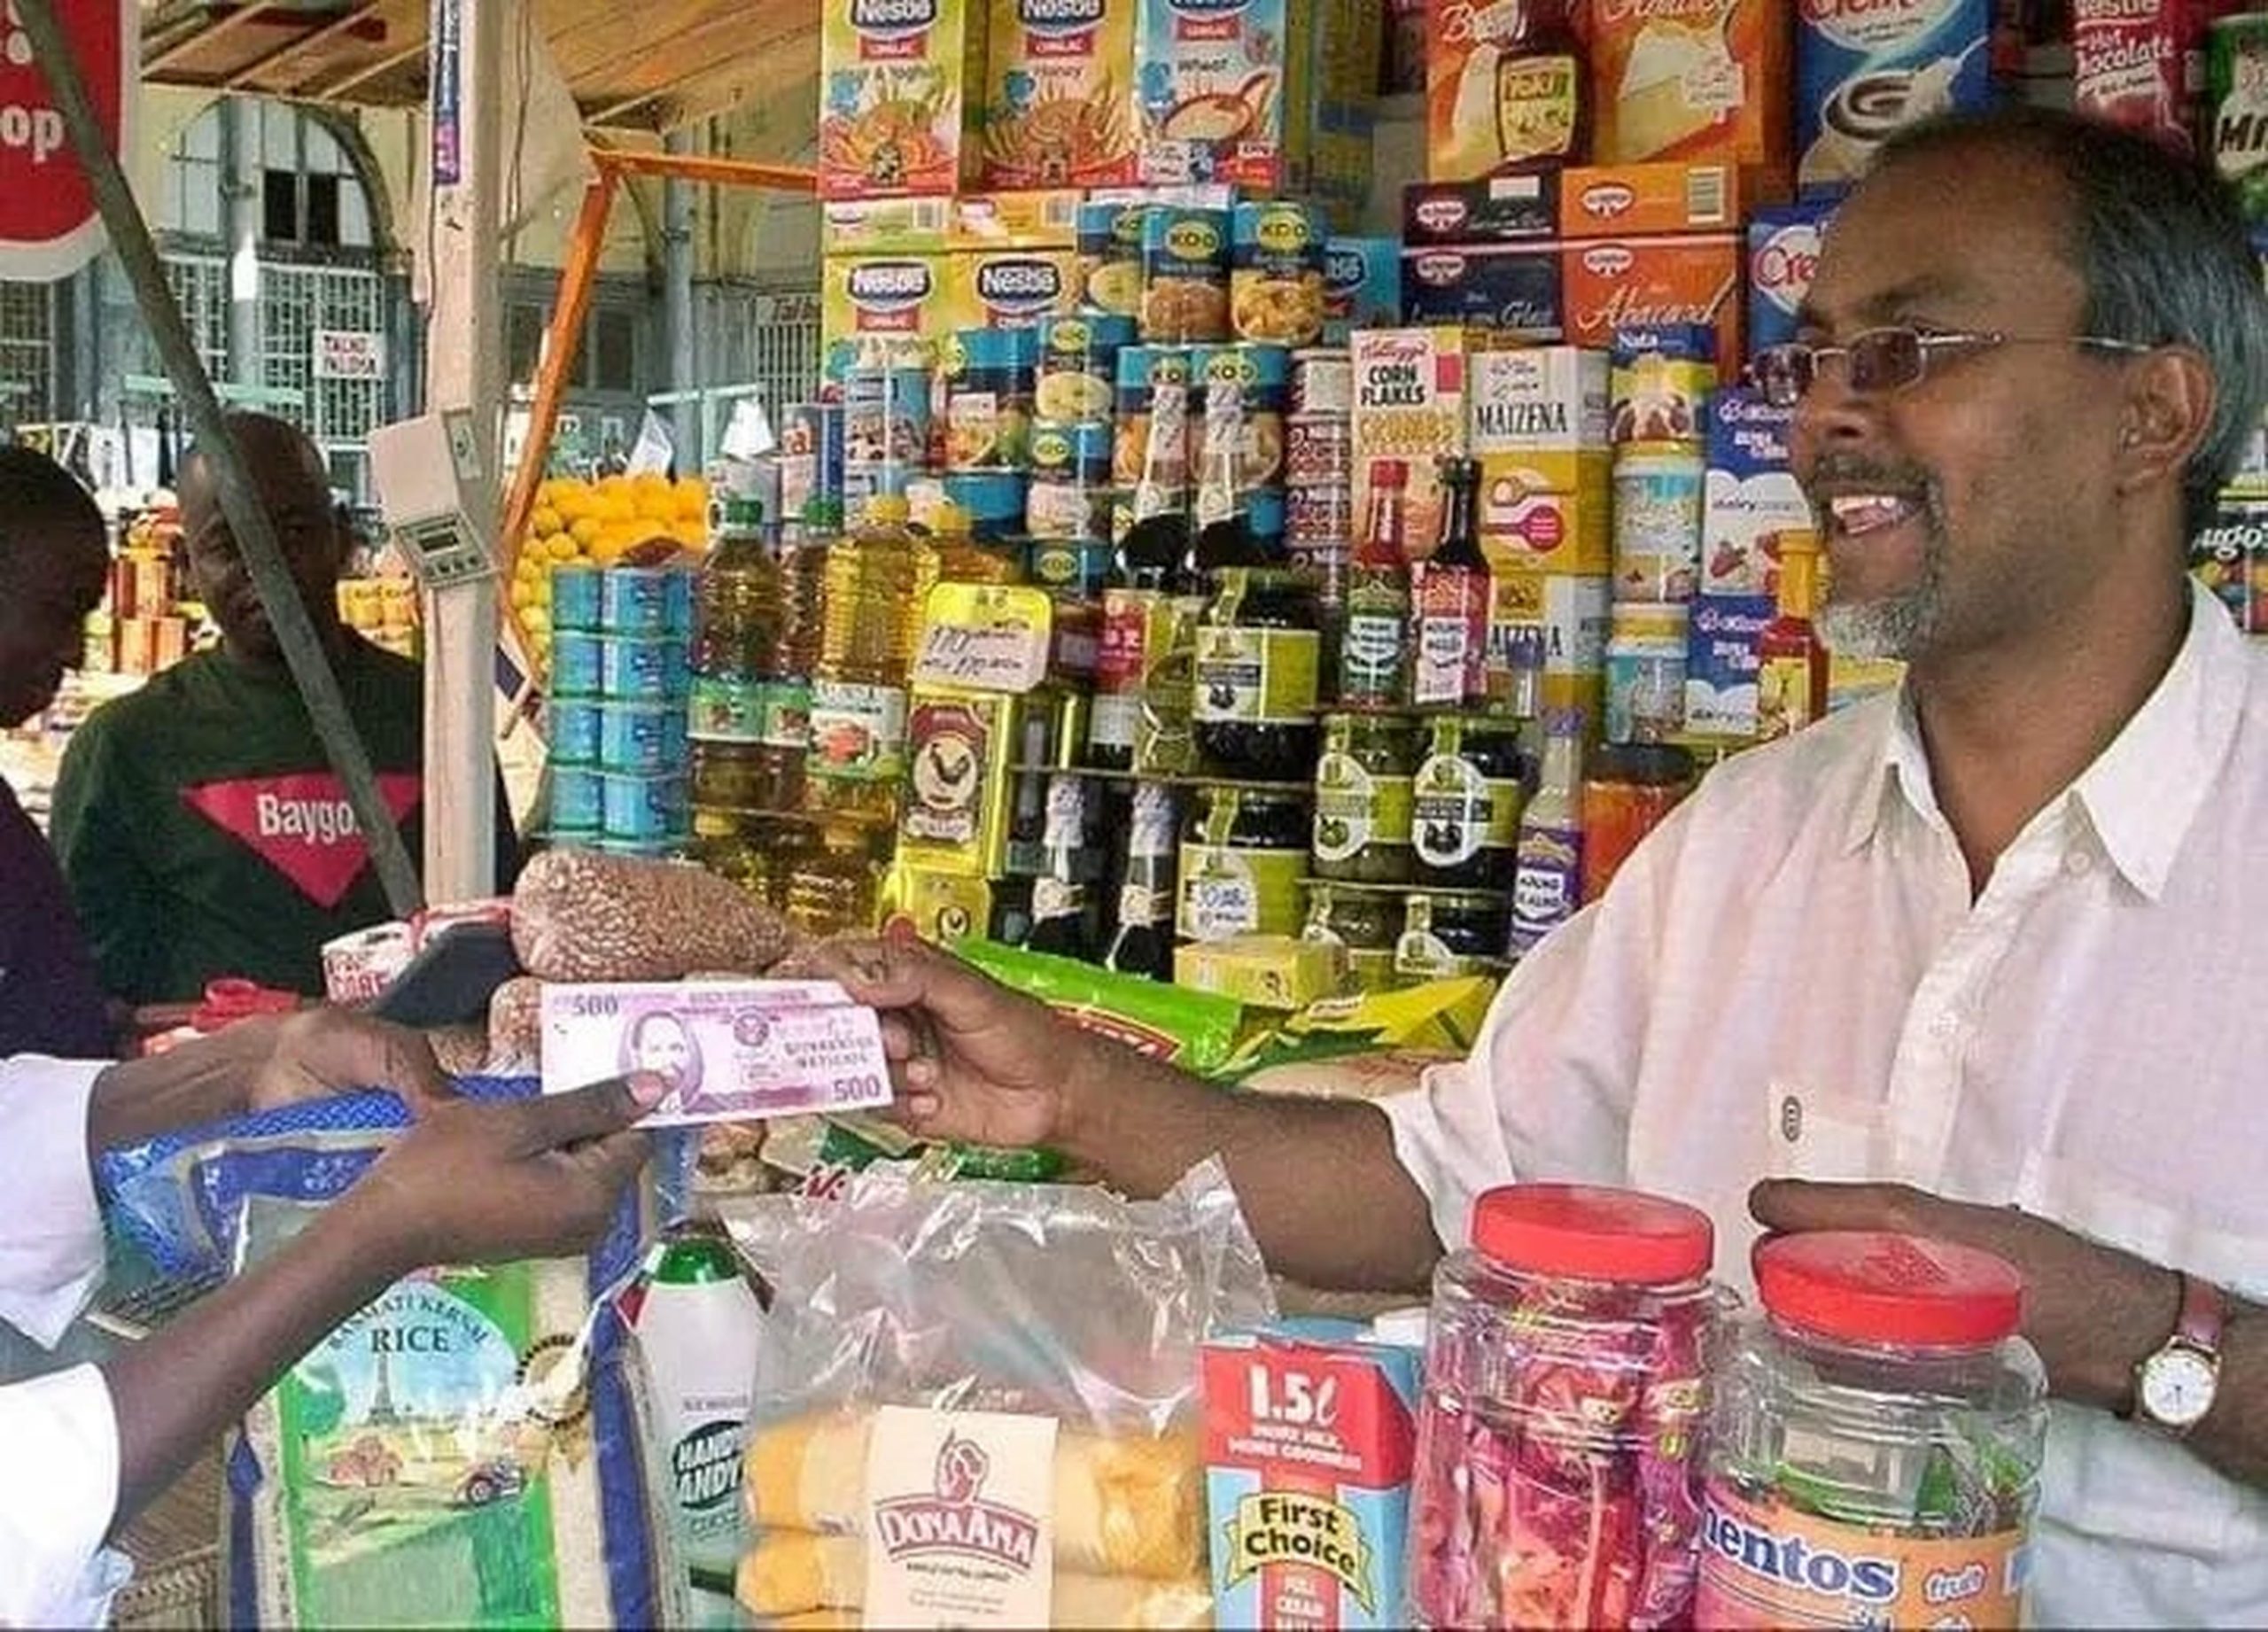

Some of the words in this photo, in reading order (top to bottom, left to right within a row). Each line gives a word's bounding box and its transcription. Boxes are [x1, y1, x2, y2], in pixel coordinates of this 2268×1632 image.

[2218, 115, 2268, 152] MI
[1369, 364, 1417, 385] CORN
[1361, 385, 1425, 406] FLAKES
[1476, 401, 1568, 435] MAIZENA
[257, 793, 362, 844] Baygo
[571, 993, 618, 1018] 500
[833, 1075, 881, 1102] 500
[370, 1326, 451, 1354] RICE
[1259, 1497, 1340, 1535] First
[1244, 1528, 1355, 1575] Choice
